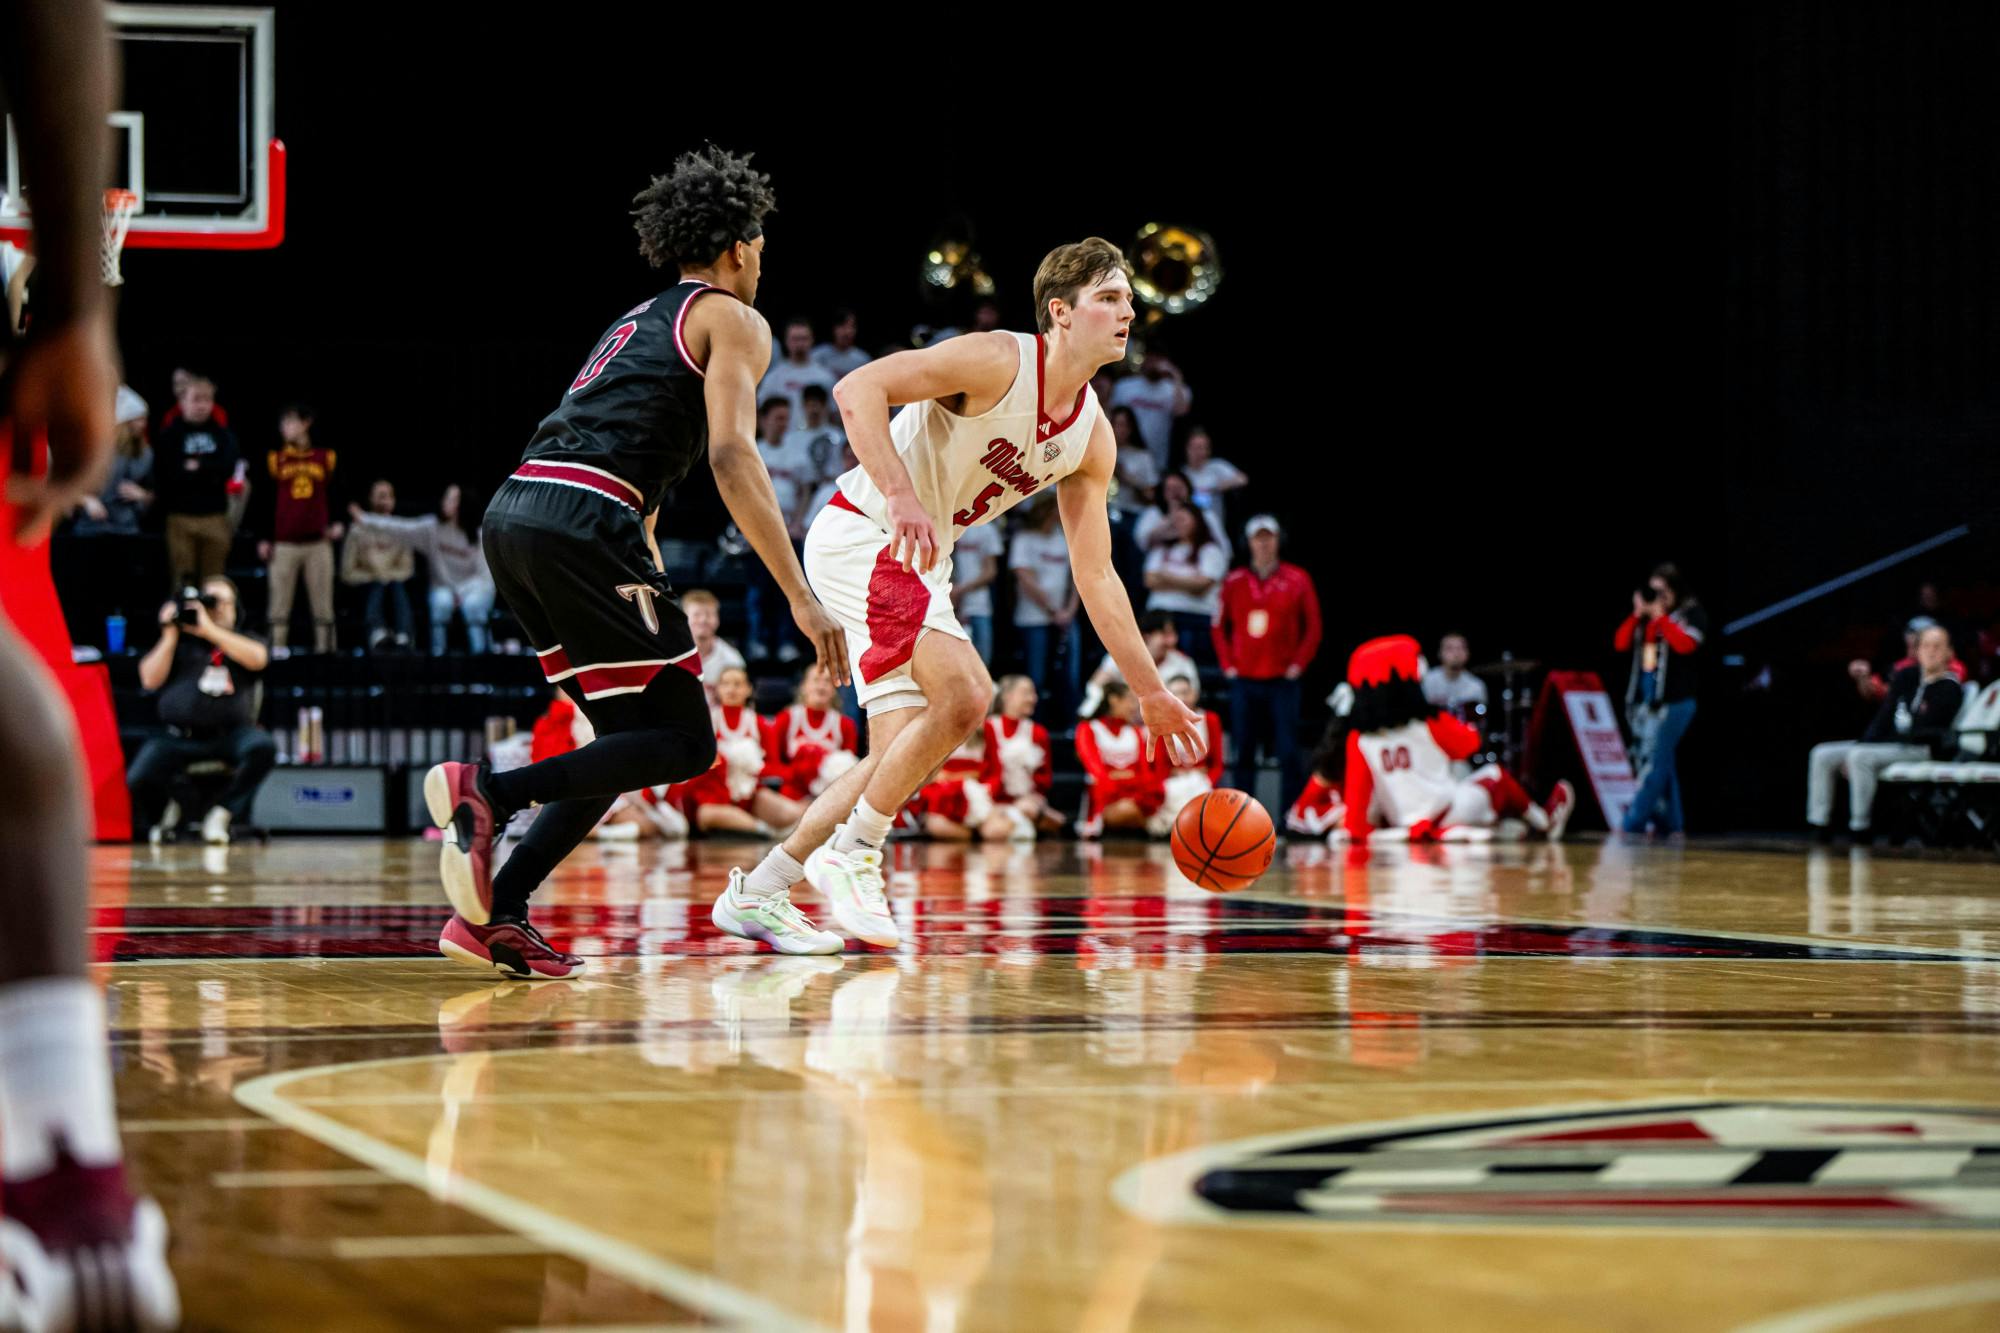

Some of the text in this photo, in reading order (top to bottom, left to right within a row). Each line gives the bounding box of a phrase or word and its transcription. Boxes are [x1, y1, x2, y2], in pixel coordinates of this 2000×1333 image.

[569, 320, 638, 395] 0
[980, 437, 1054, 496] Miami
[953, 481, 1005, 527] 5
